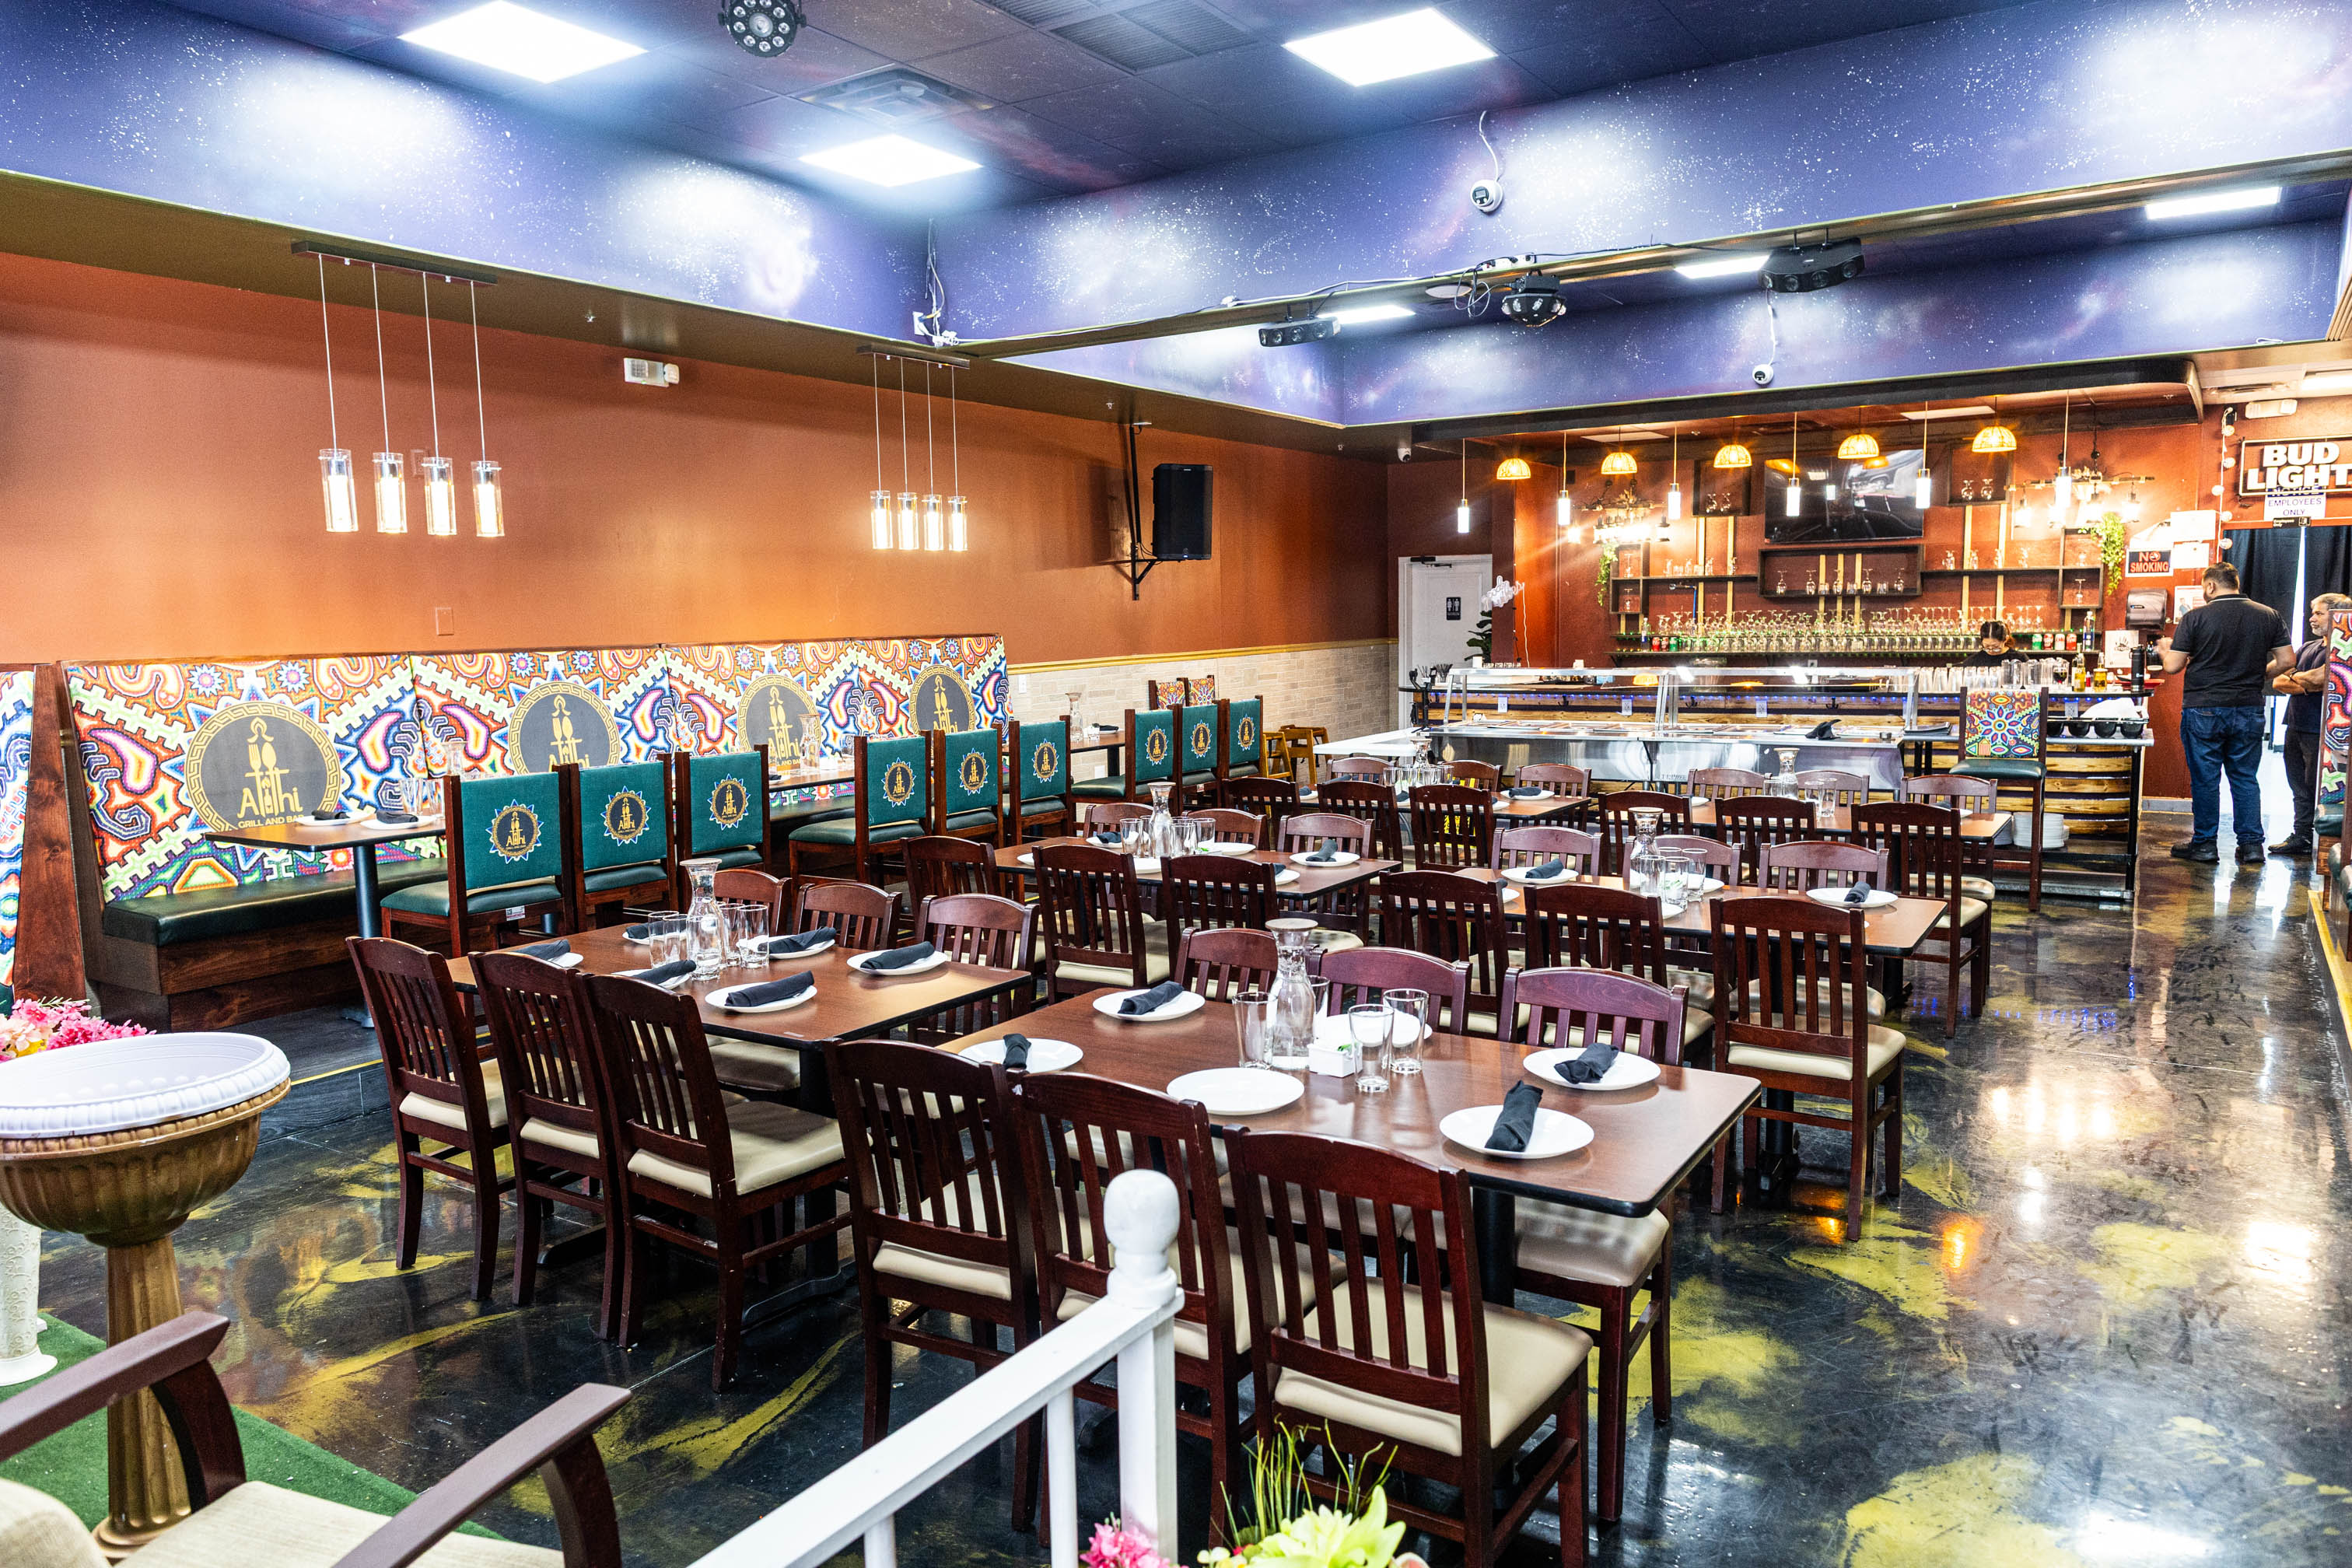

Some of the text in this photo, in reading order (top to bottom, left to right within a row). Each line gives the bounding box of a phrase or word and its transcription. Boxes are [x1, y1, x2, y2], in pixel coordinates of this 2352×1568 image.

[2263, 442, 2340, 467] BUD
[2247, 463, 2352, 490] LIGHT
[2268, 498, 2322, 506] EMPLOYEES
[2139, 551, 2161, 562] NO
[2130, 562, 2169, 572] SMOKING
[238, 819, 264, 828] GRILL
[265, 817, 285, 825] AND
